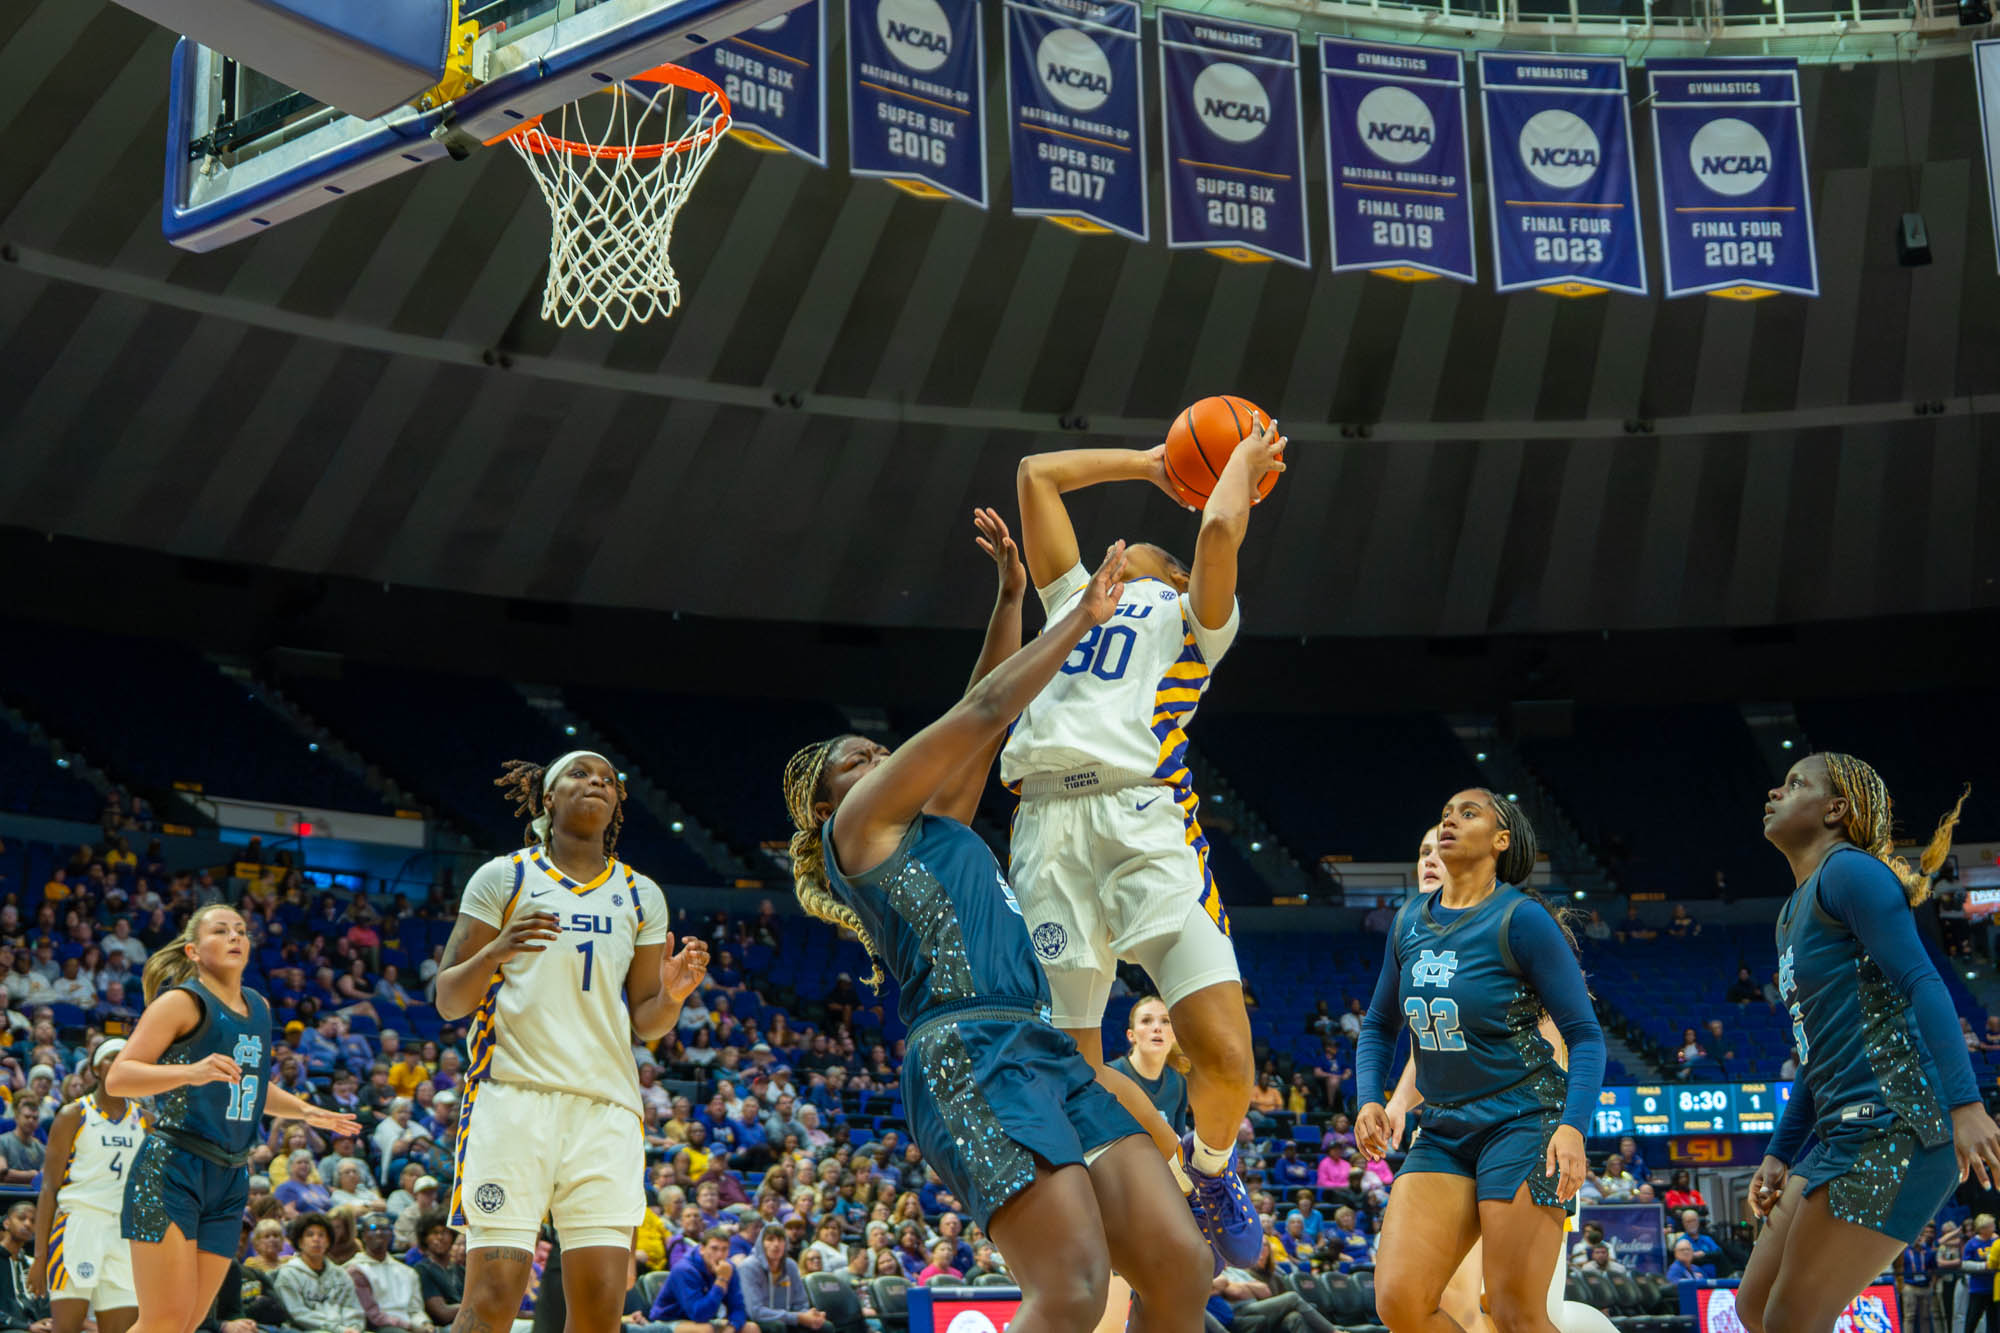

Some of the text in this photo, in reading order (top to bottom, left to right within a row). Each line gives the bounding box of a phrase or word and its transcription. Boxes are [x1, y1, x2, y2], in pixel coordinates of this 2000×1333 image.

[887, 20, 949, 55] NCAA
[1194, 26, 1262, 49] GYMNASTICS
[714, 47, 793, 89] SUPER SIX
[1357, 52, 1427, 71] GYMNASTICS
[1516, 66, 1589, 80] GYMNASTICS
[860, 63, 910, 88] NATIONAL
[1047, 62, 1110, 95] NCAA
[725, 74, 784, 118] 2014
[1688, 82, 1760, 94] GYMNASTICS
[877, 101, 955, 137] SUPER SIX
[1021, 105, 1070, 128] NATIONAL
[1203, 97, 1268, 125] NCAA
[1367, 122, 1432, 145] NCAA
[888, 126, 947, 167] 2016
[1038, 142, 1115, 174] SUPER SIX
[1530, 147, 1599, 167] NCAA
[1343, 167, 1393, 182] NATIONAL
[1702, 155, 1769, 174] NCAA
[1050, 166, 1105, 201] 2017
[1196, 177, 1275, 203] SUPER SIX
[1207, 200, 1267, 231] 2018
[1358, 200, 1445, 222] FINAL FOUR
[1373, 221, 1433, 249] 2019
[1522, 216, 1612, 234] FINAL FOUR
[1692, 222, 1782, 237] FINAL FOUR
[1534, 237, 1603, 263] 2023
[1705, 242, 1774, 266] 2024
[1060, 624, 1137, 681] 30
[1064, 770, 1097, 783] BEAUX
[1064, 777, 1099, 790] TIGERS
[576, 940, 593, 992] 1
[1403, 996, 1468, 1051] 22
[225, 1074, 258, 1120] 12
[1644, 1097, 1657, 1113] 0
[1679, 1090, 1727, 1111] 8:30
[1750, 1094, 1760, 1110] 1
[1596, 1110, 1623, 1133] 15
[1713, 1116, 1724, 1130] 2
[1862, 1107, 1869, 1116] M
[101, 1135, 133, 1148] LSU
[1671, 1138, 1733, 1162] LSU
[109, 1151, 122, 1180] 4
